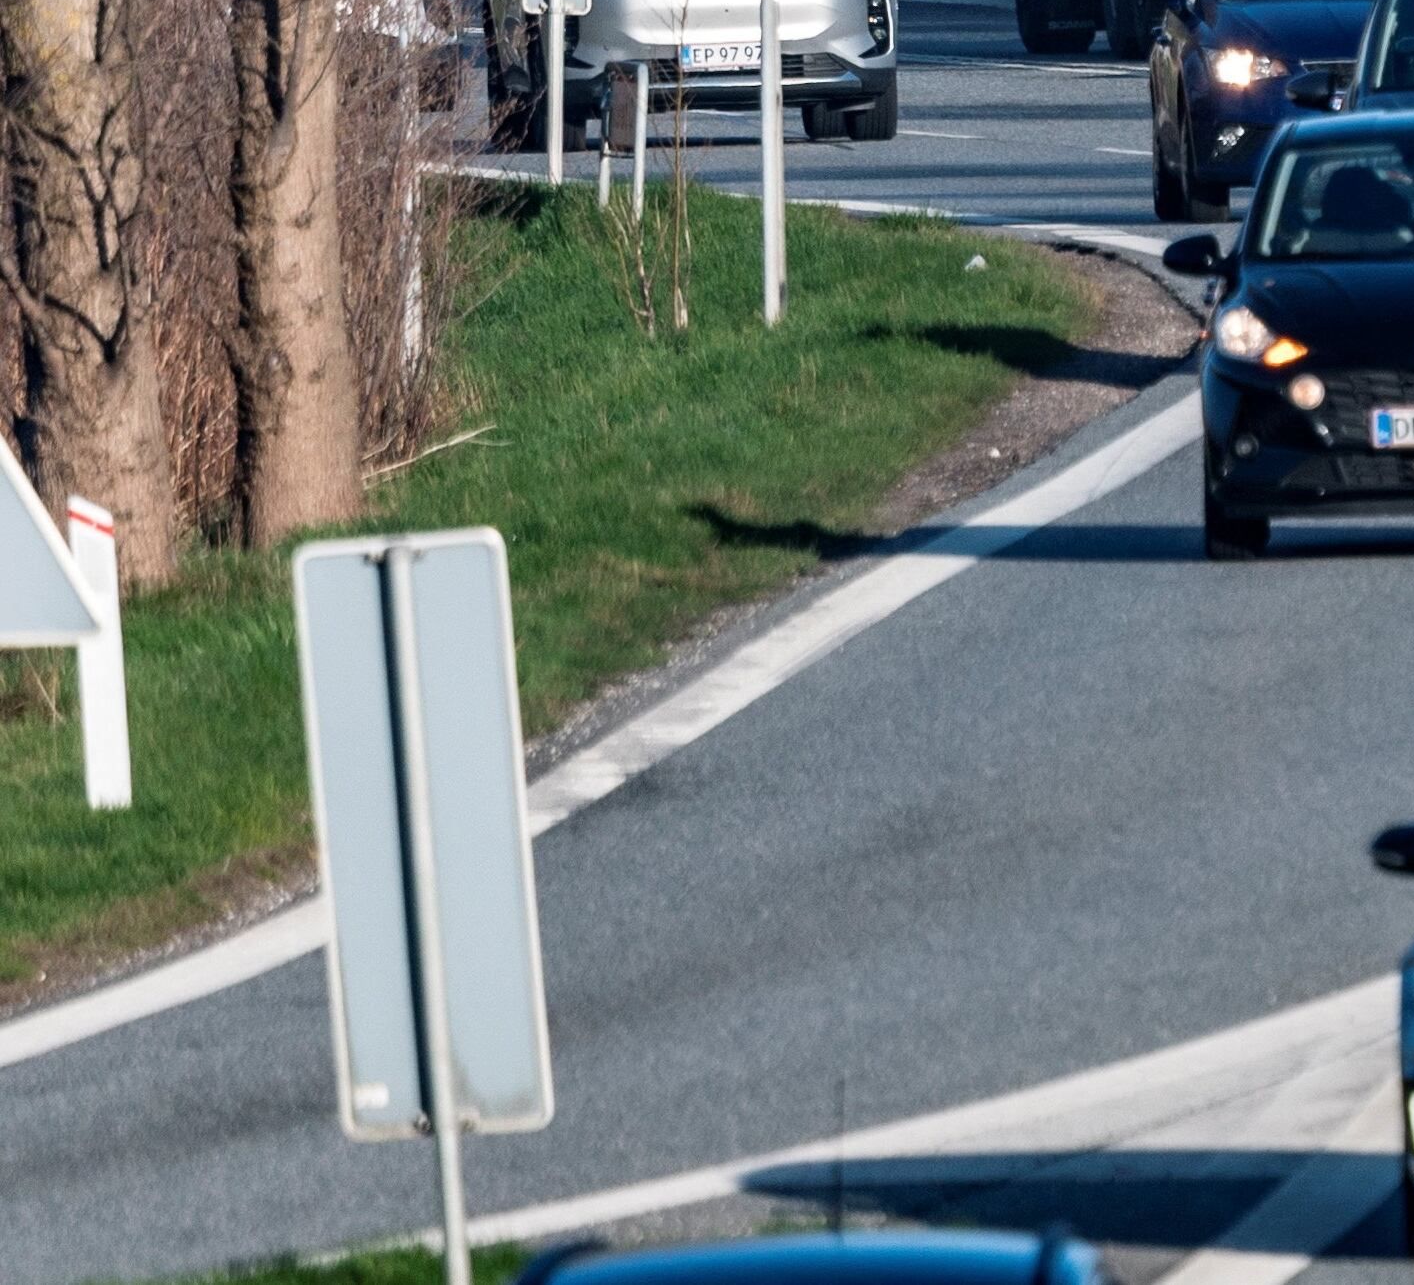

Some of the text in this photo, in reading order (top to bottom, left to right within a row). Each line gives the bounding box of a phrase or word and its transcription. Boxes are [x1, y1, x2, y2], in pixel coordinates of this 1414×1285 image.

[692, 45, 762, 64] EP 97 97
